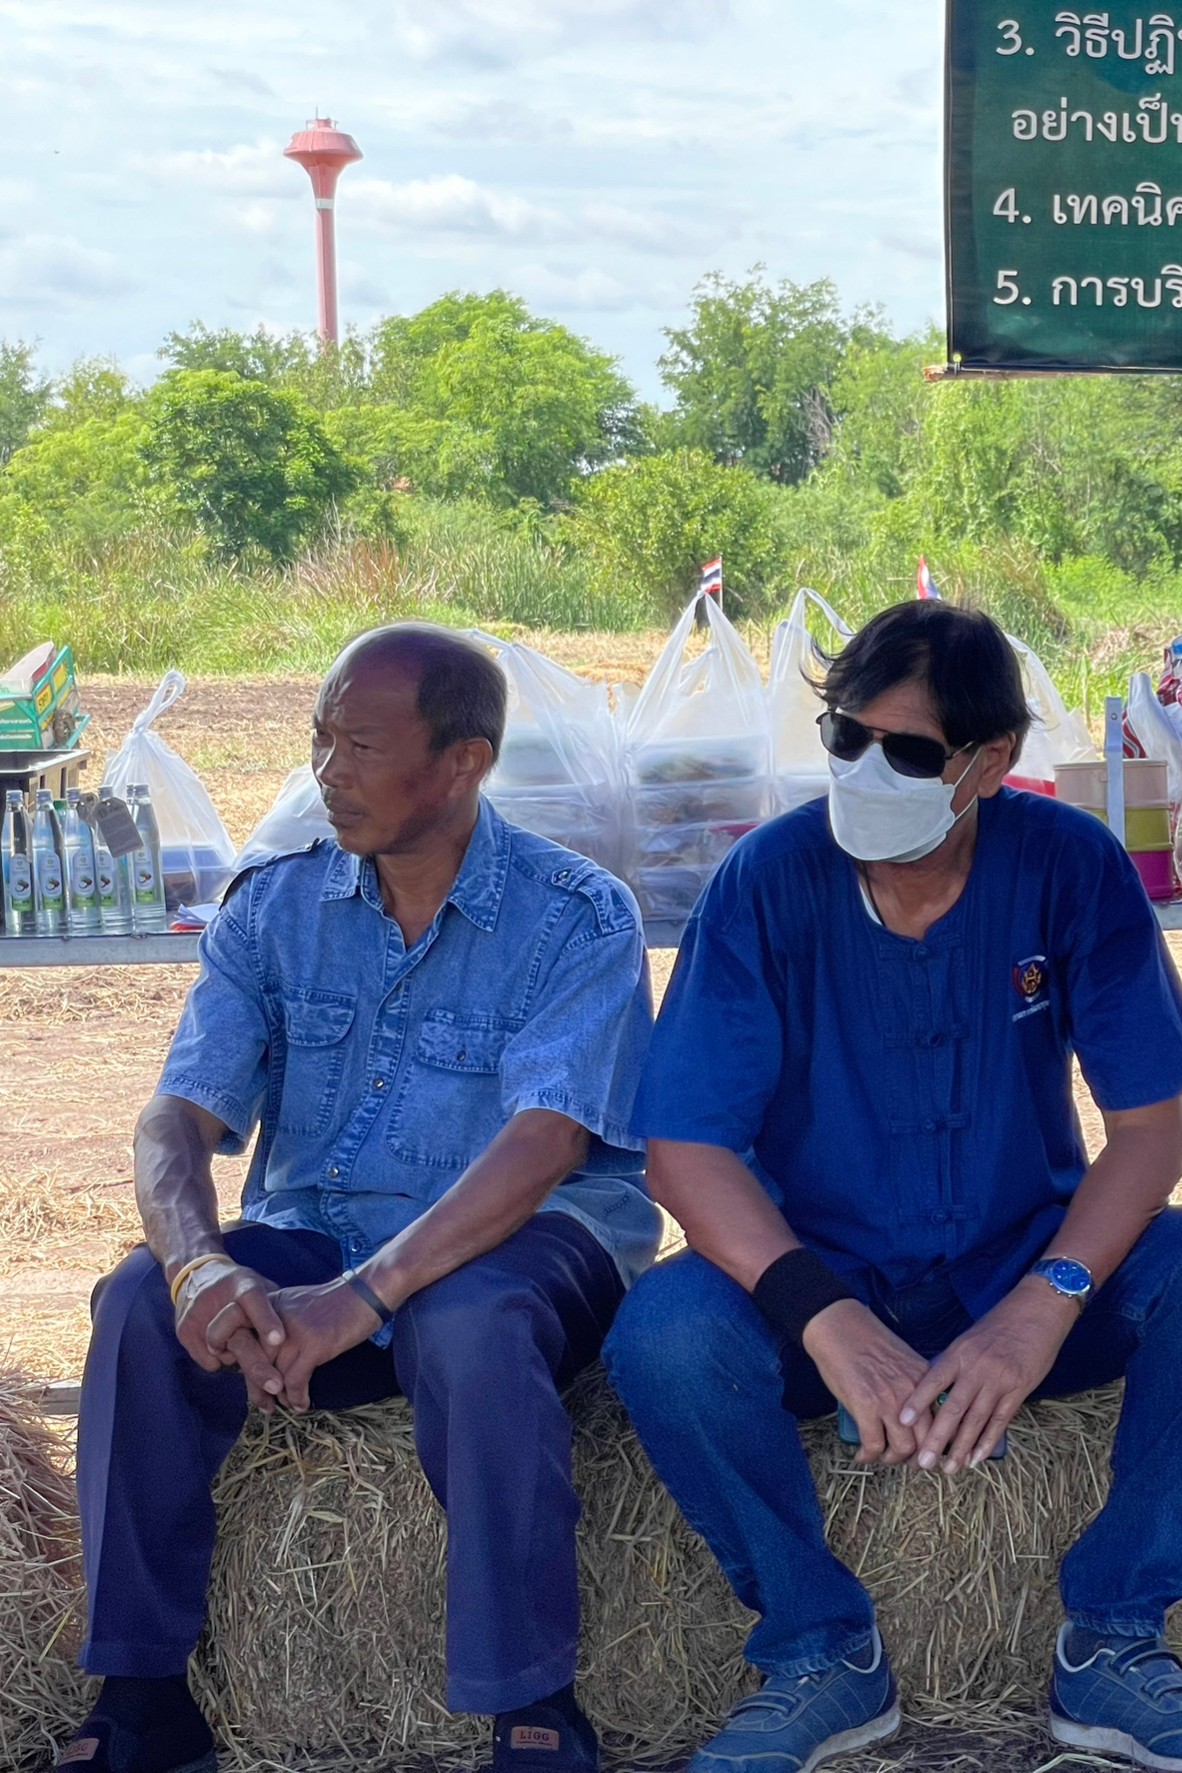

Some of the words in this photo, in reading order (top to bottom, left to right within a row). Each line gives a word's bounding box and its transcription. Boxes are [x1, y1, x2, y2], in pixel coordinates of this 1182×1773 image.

[995, 19, 1035, 56] 3.
[992, 187, 1032, 224] 4.
[992, 269, 1032, 306] 5.
